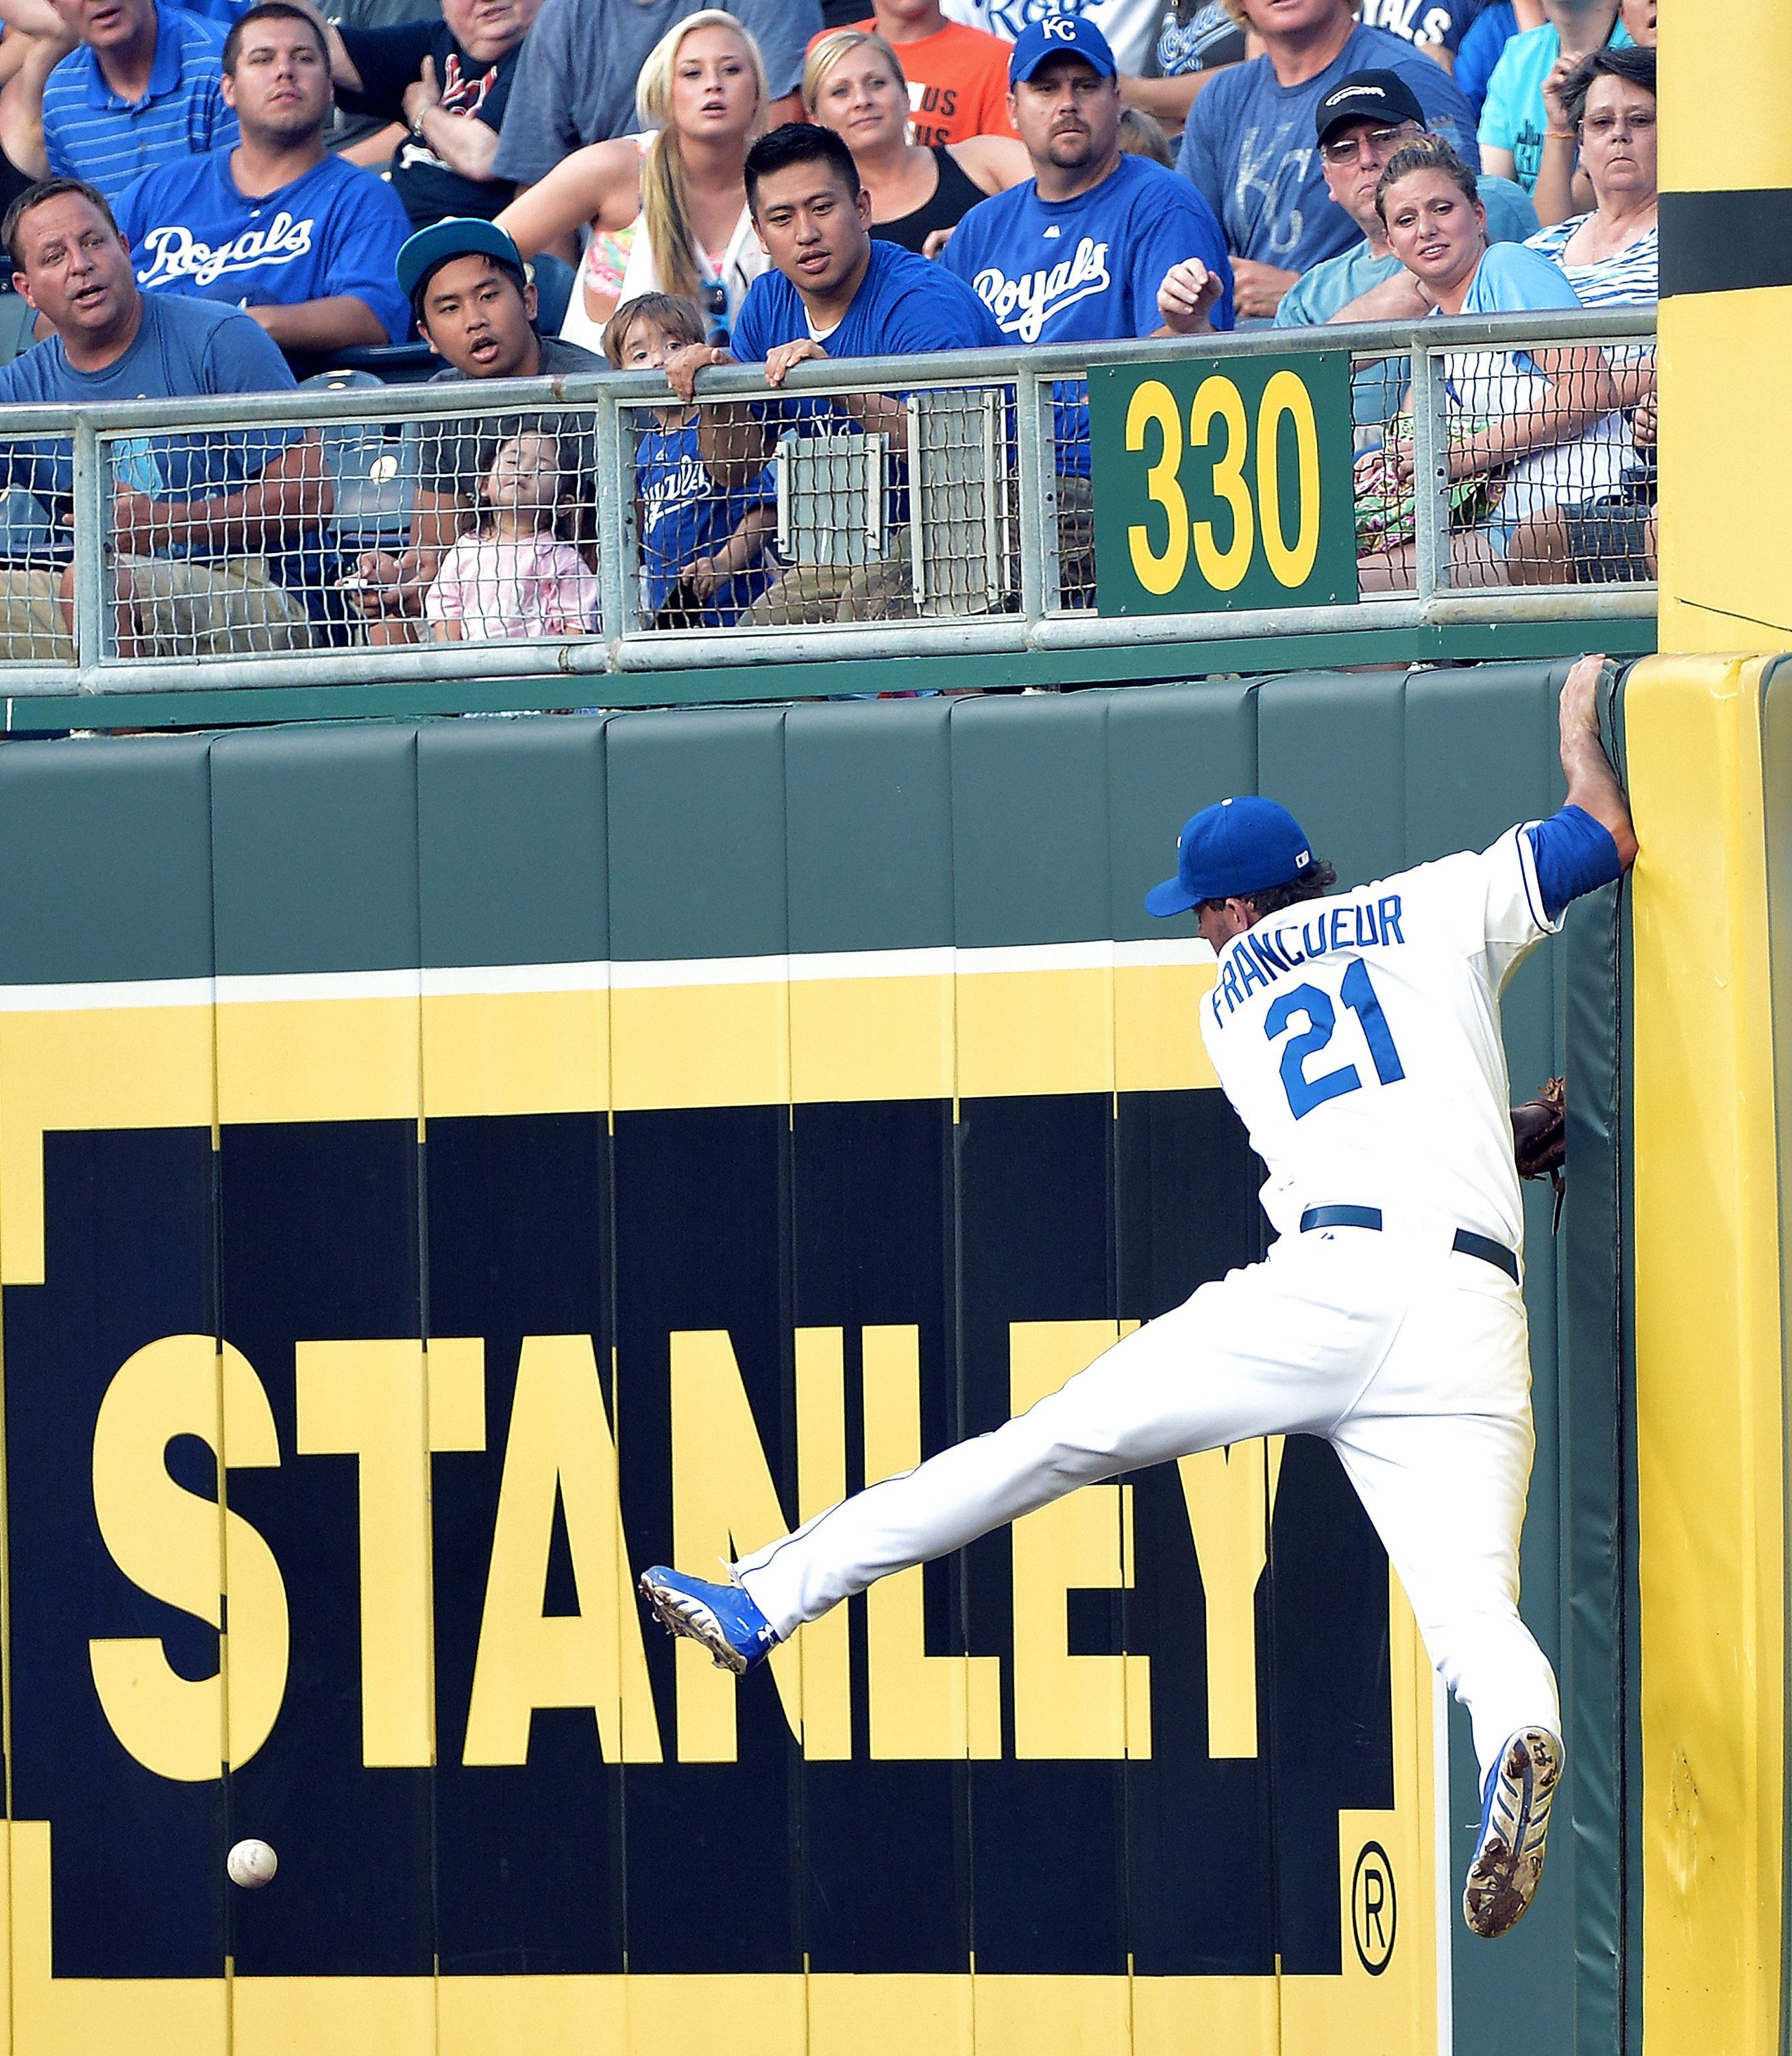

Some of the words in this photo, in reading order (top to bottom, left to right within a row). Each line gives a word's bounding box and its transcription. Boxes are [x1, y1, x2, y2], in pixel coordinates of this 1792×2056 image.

[1041, 16, 1077, 41] KC
[136, 211, 315, 286] Royals
[1236, 121, 1313, 255] KC
[972, 236, 1111, 343] Royals
[1125, 370, 1321, 596] 330
[1263, 957, 1406, 1121] 21
[89, 1319, 1286, 1783] STANLEY
